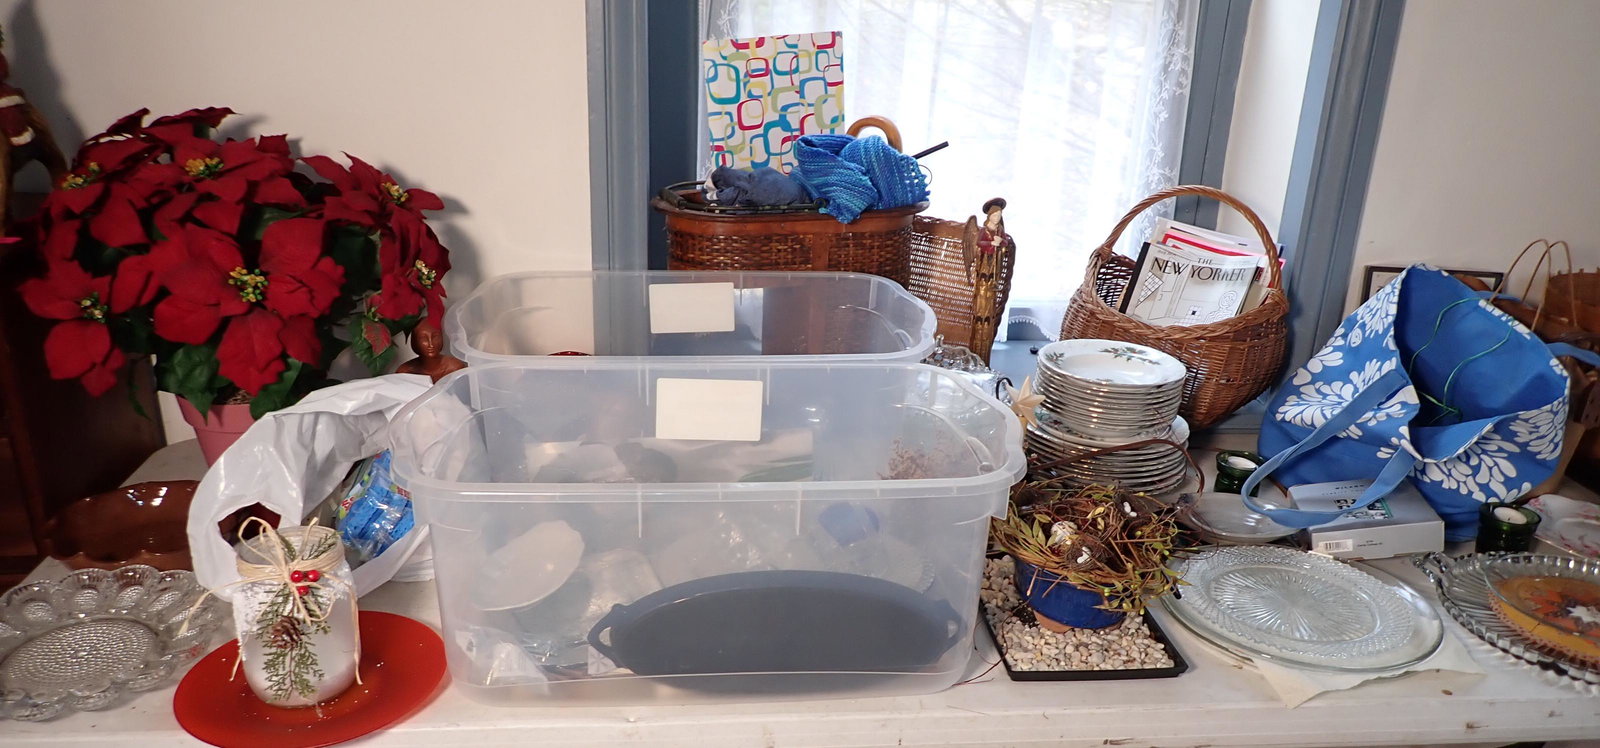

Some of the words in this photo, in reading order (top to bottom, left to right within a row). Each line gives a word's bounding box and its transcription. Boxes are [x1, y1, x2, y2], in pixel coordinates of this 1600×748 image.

[1151, 257, 1189, 276] NEW
[1191, 264, 1247, 281] YORKER
[1197, 257, 1213, 265] THE
